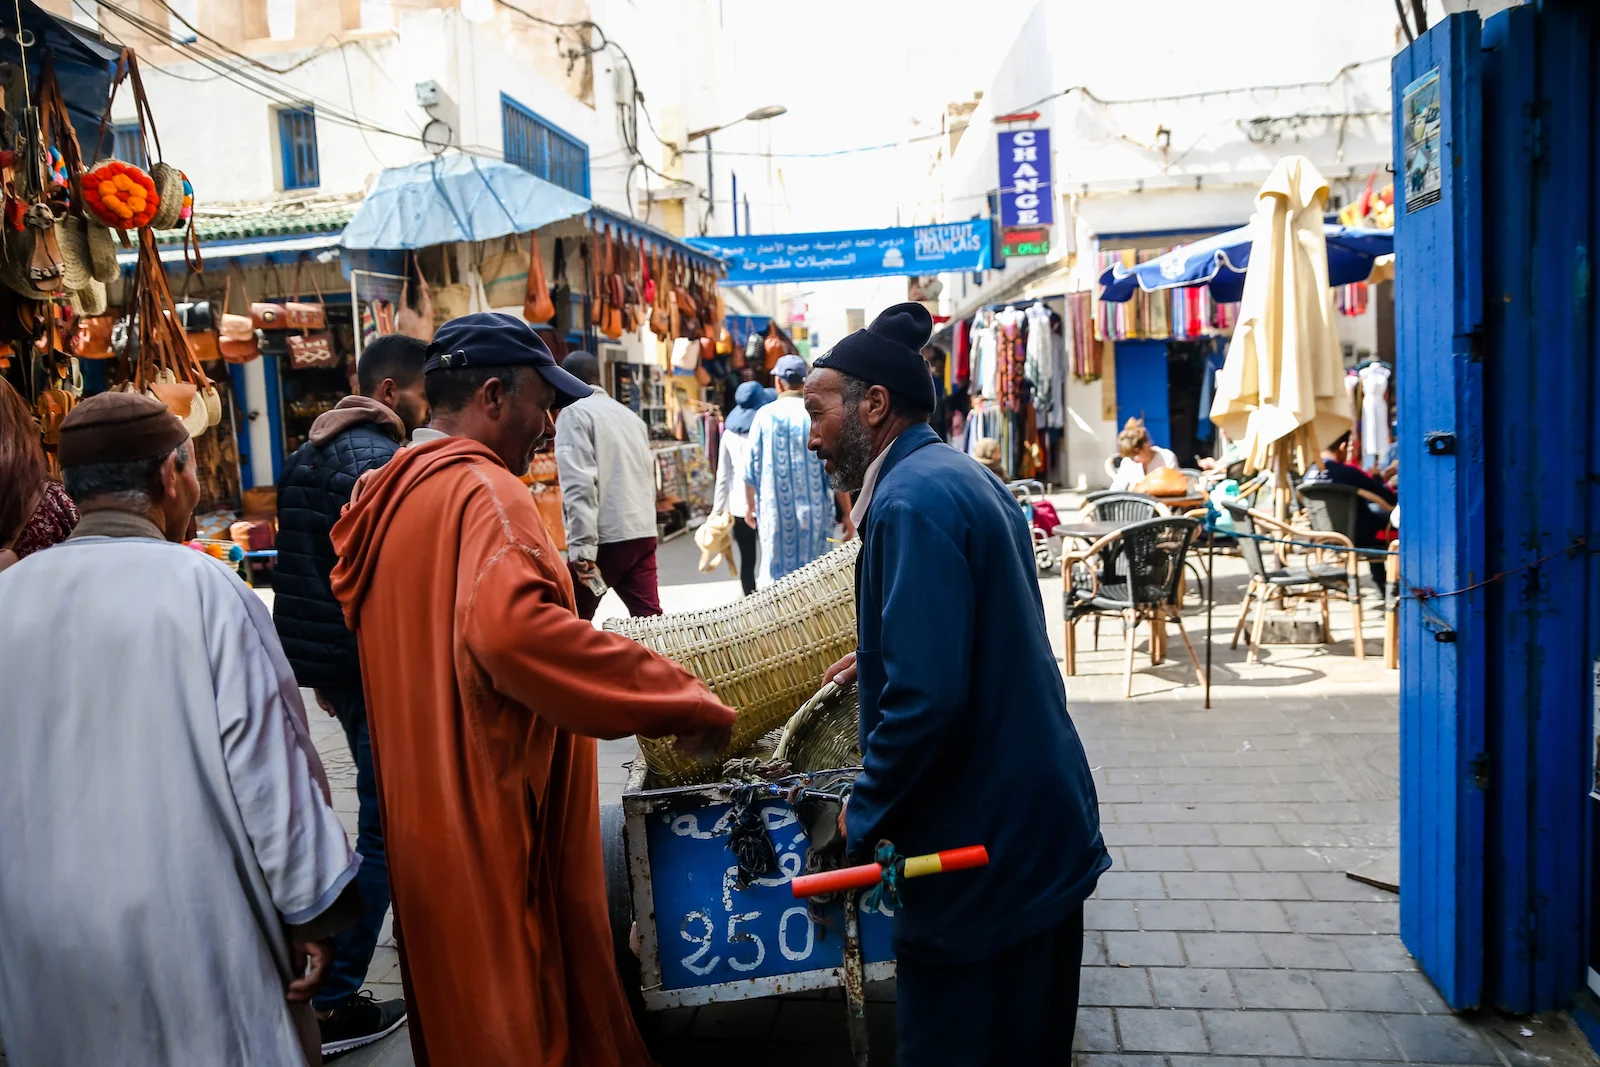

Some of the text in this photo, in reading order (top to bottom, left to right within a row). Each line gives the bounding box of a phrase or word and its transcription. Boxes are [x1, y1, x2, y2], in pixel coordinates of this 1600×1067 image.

[1012, 131, 1040, 225] CHANGE
[742, 252, 857, 273] التسجيلات مفتوحة
[679, 906, 815, 976] 250
